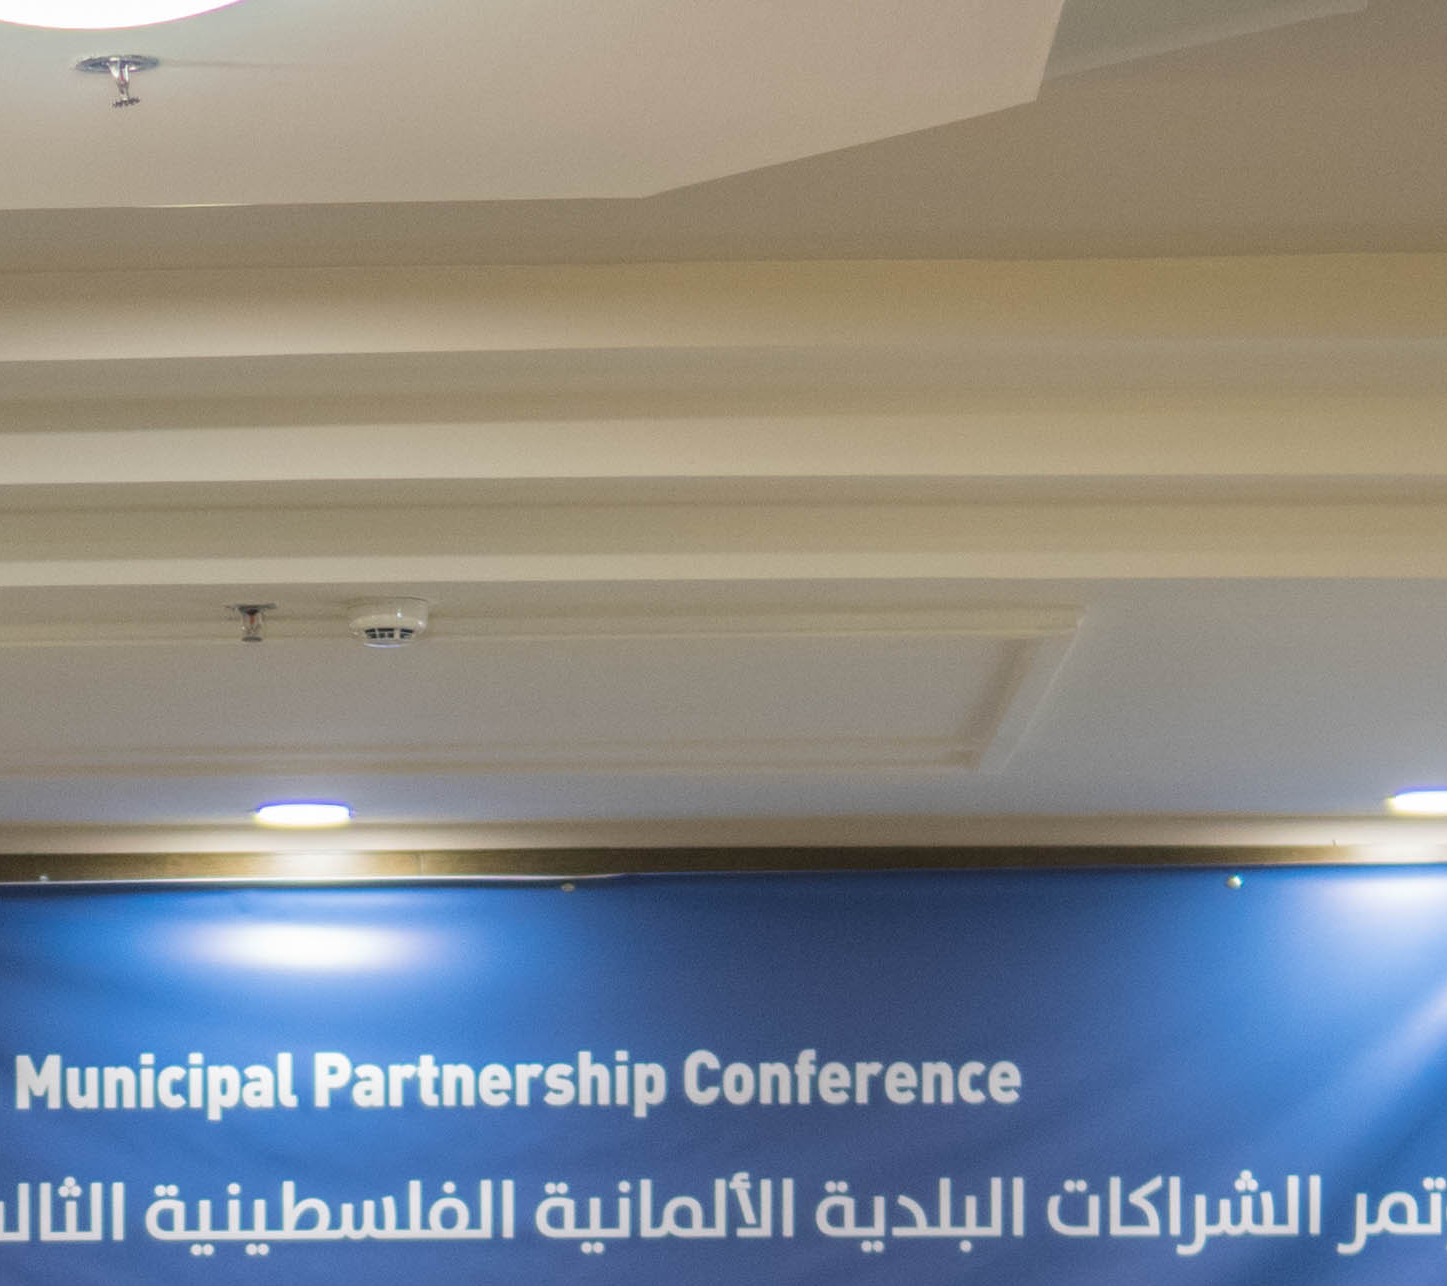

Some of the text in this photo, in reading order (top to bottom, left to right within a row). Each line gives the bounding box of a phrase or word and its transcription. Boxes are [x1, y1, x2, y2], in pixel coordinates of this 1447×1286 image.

[16, 1051, 299, 1121] Municipal
[313, 1050, 666, 1117] Partnership
[684, 1050, 1022, 1104] Conference
[145, 1179, 515, 1257] الفلسطينية
[535, 1172, 795, 1254] الألمانية
[816, 1178, 1025, 1252] البلدية
[1047, 1170, 1322, 1256] الشراكات
